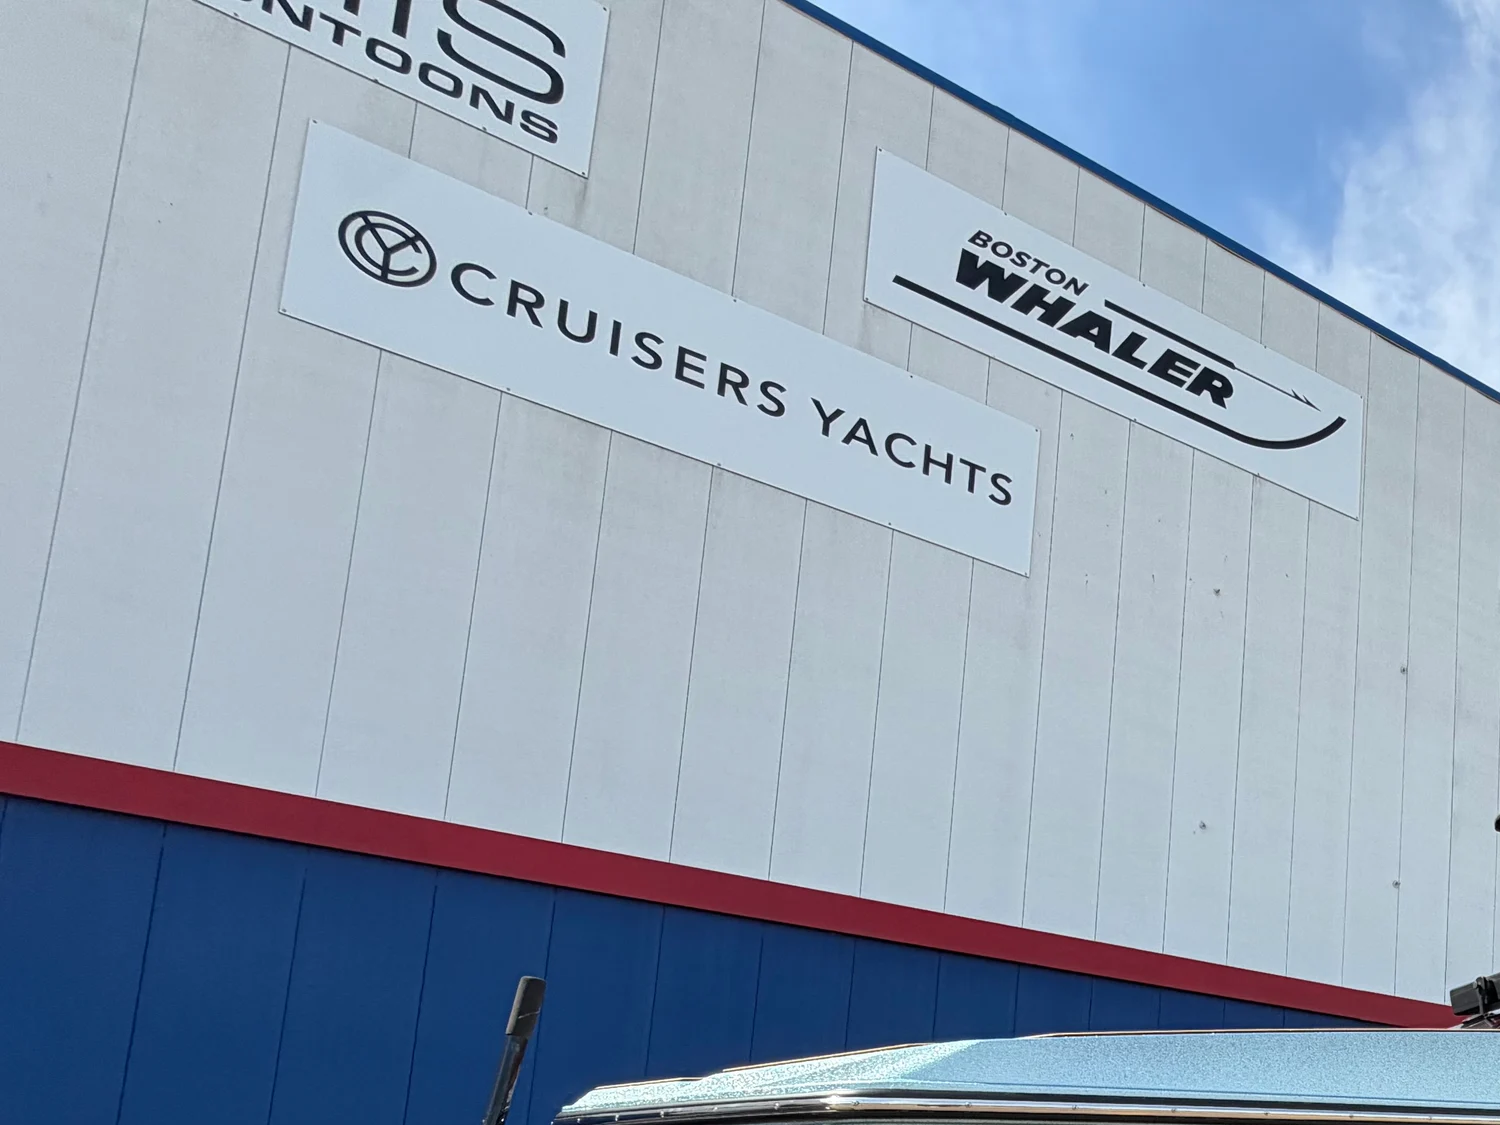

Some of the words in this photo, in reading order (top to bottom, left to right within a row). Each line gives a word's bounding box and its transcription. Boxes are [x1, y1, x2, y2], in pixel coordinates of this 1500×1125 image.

[242, 0, 558, 144] NTOONS
[955, 248, 1235, 410] WHALER
[967, 229, 1089, 297] BOSTON
[450, 262, 786, 418] CRUISERS
[811, 397, 1012, 506] YACHTS
